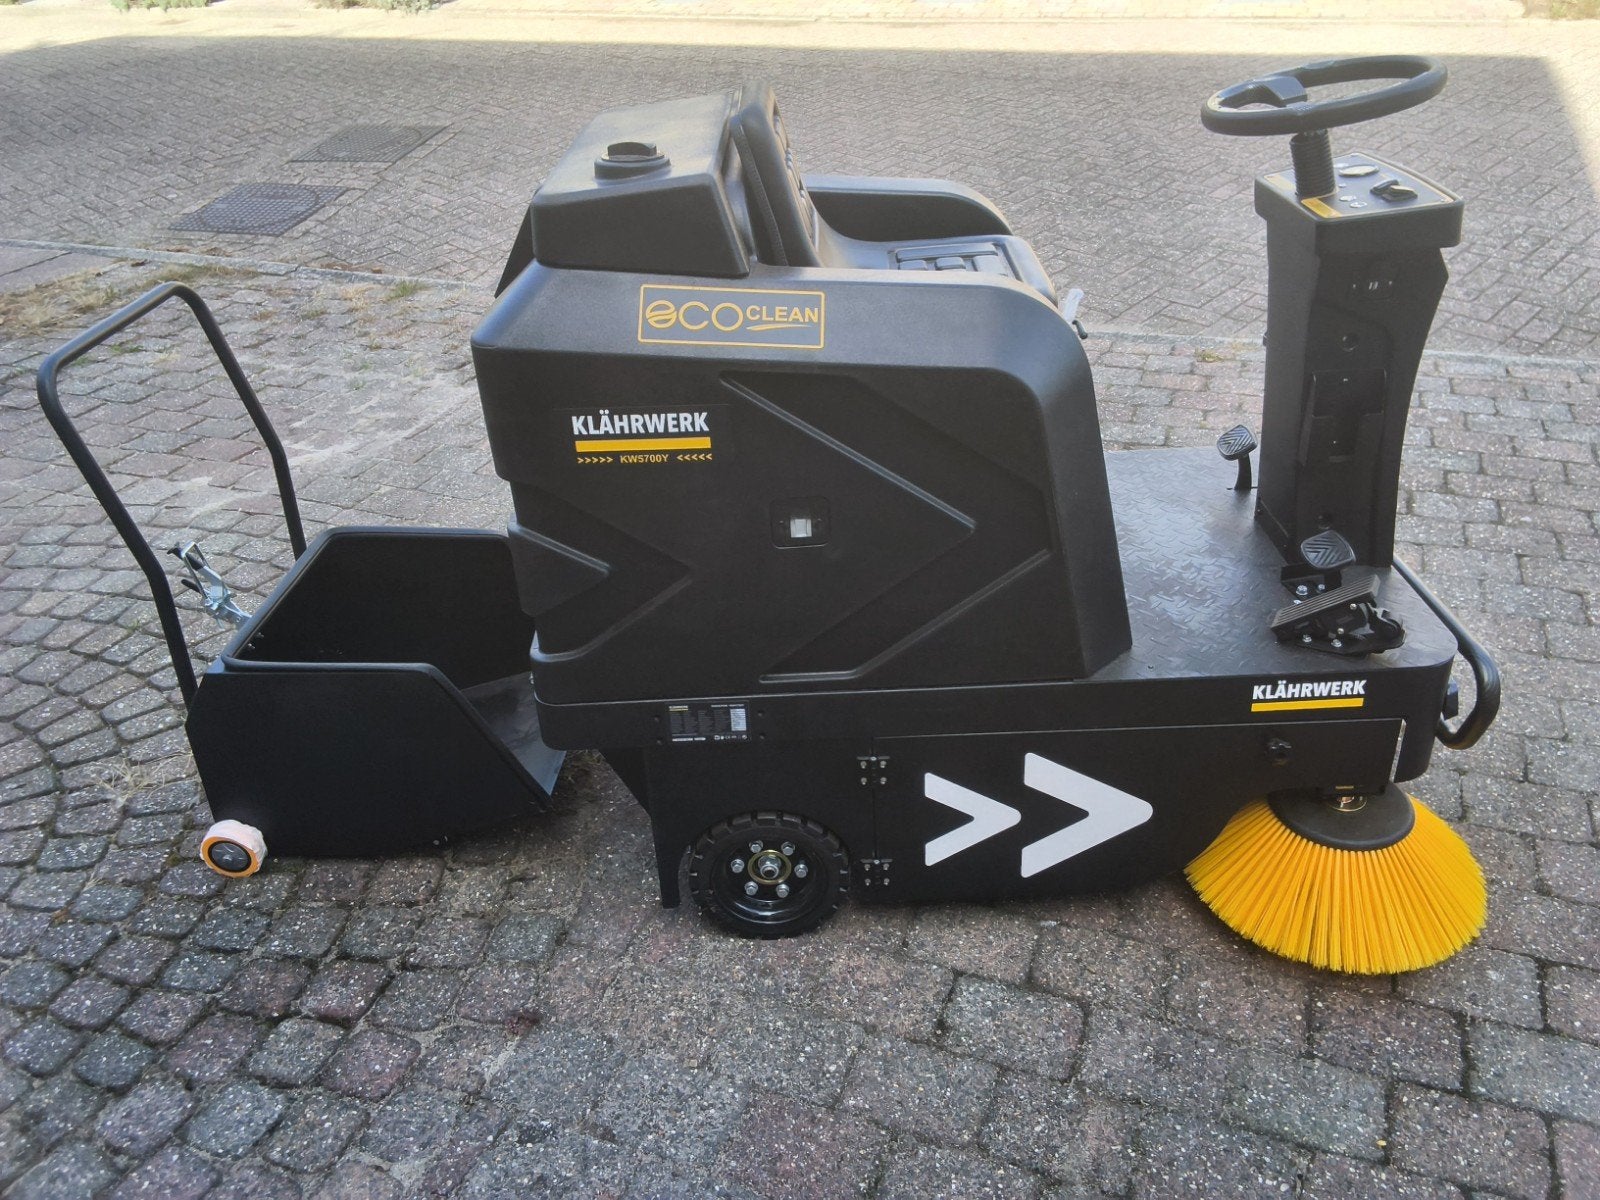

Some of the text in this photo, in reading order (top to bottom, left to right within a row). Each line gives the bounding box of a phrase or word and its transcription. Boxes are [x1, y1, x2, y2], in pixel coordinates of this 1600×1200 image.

[746, 305, 819, 323] CLEAN
[571, 409, 710, 435] KLÄHRWERK
[1252, 680, 1367, 700] KLÄHRWERK
